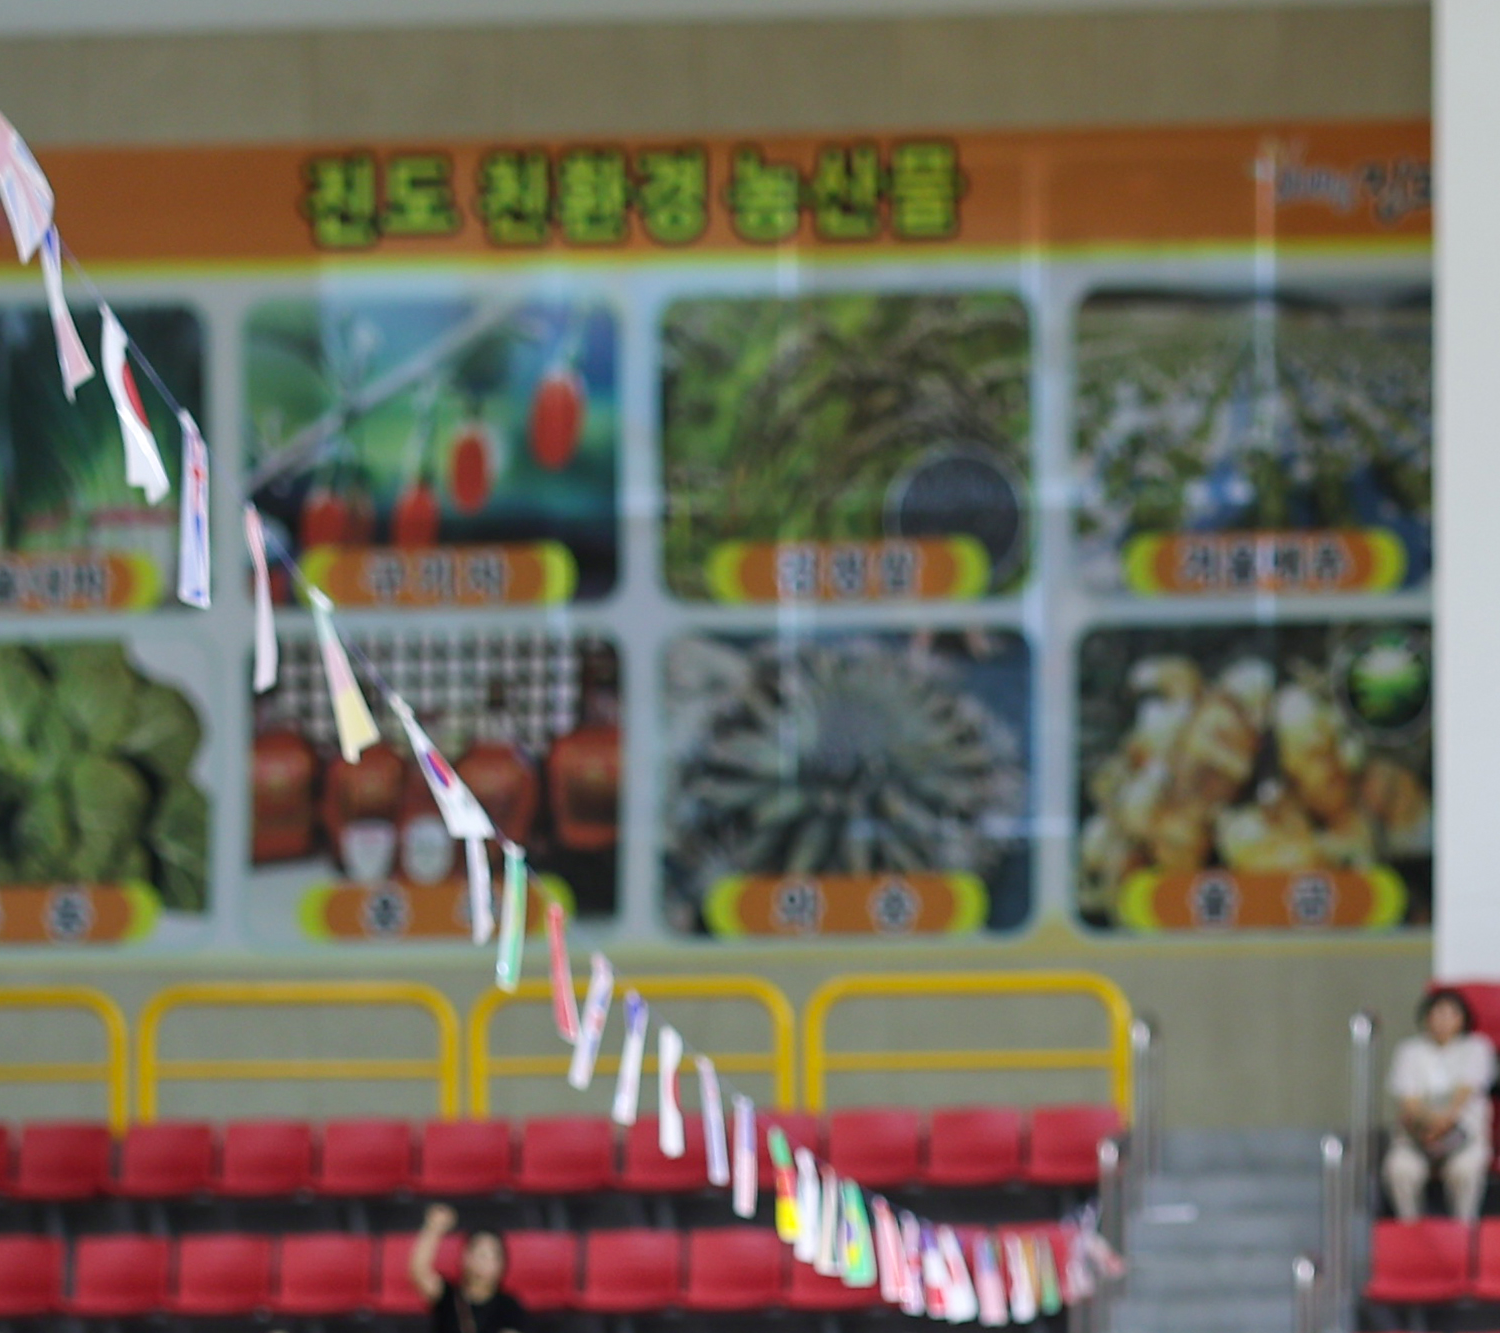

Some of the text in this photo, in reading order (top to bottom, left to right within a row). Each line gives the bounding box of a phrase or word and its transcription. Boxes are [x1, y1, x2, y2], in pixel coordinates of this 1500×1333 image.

[305, 140, 964, 248] 진도 친환경 농산물
